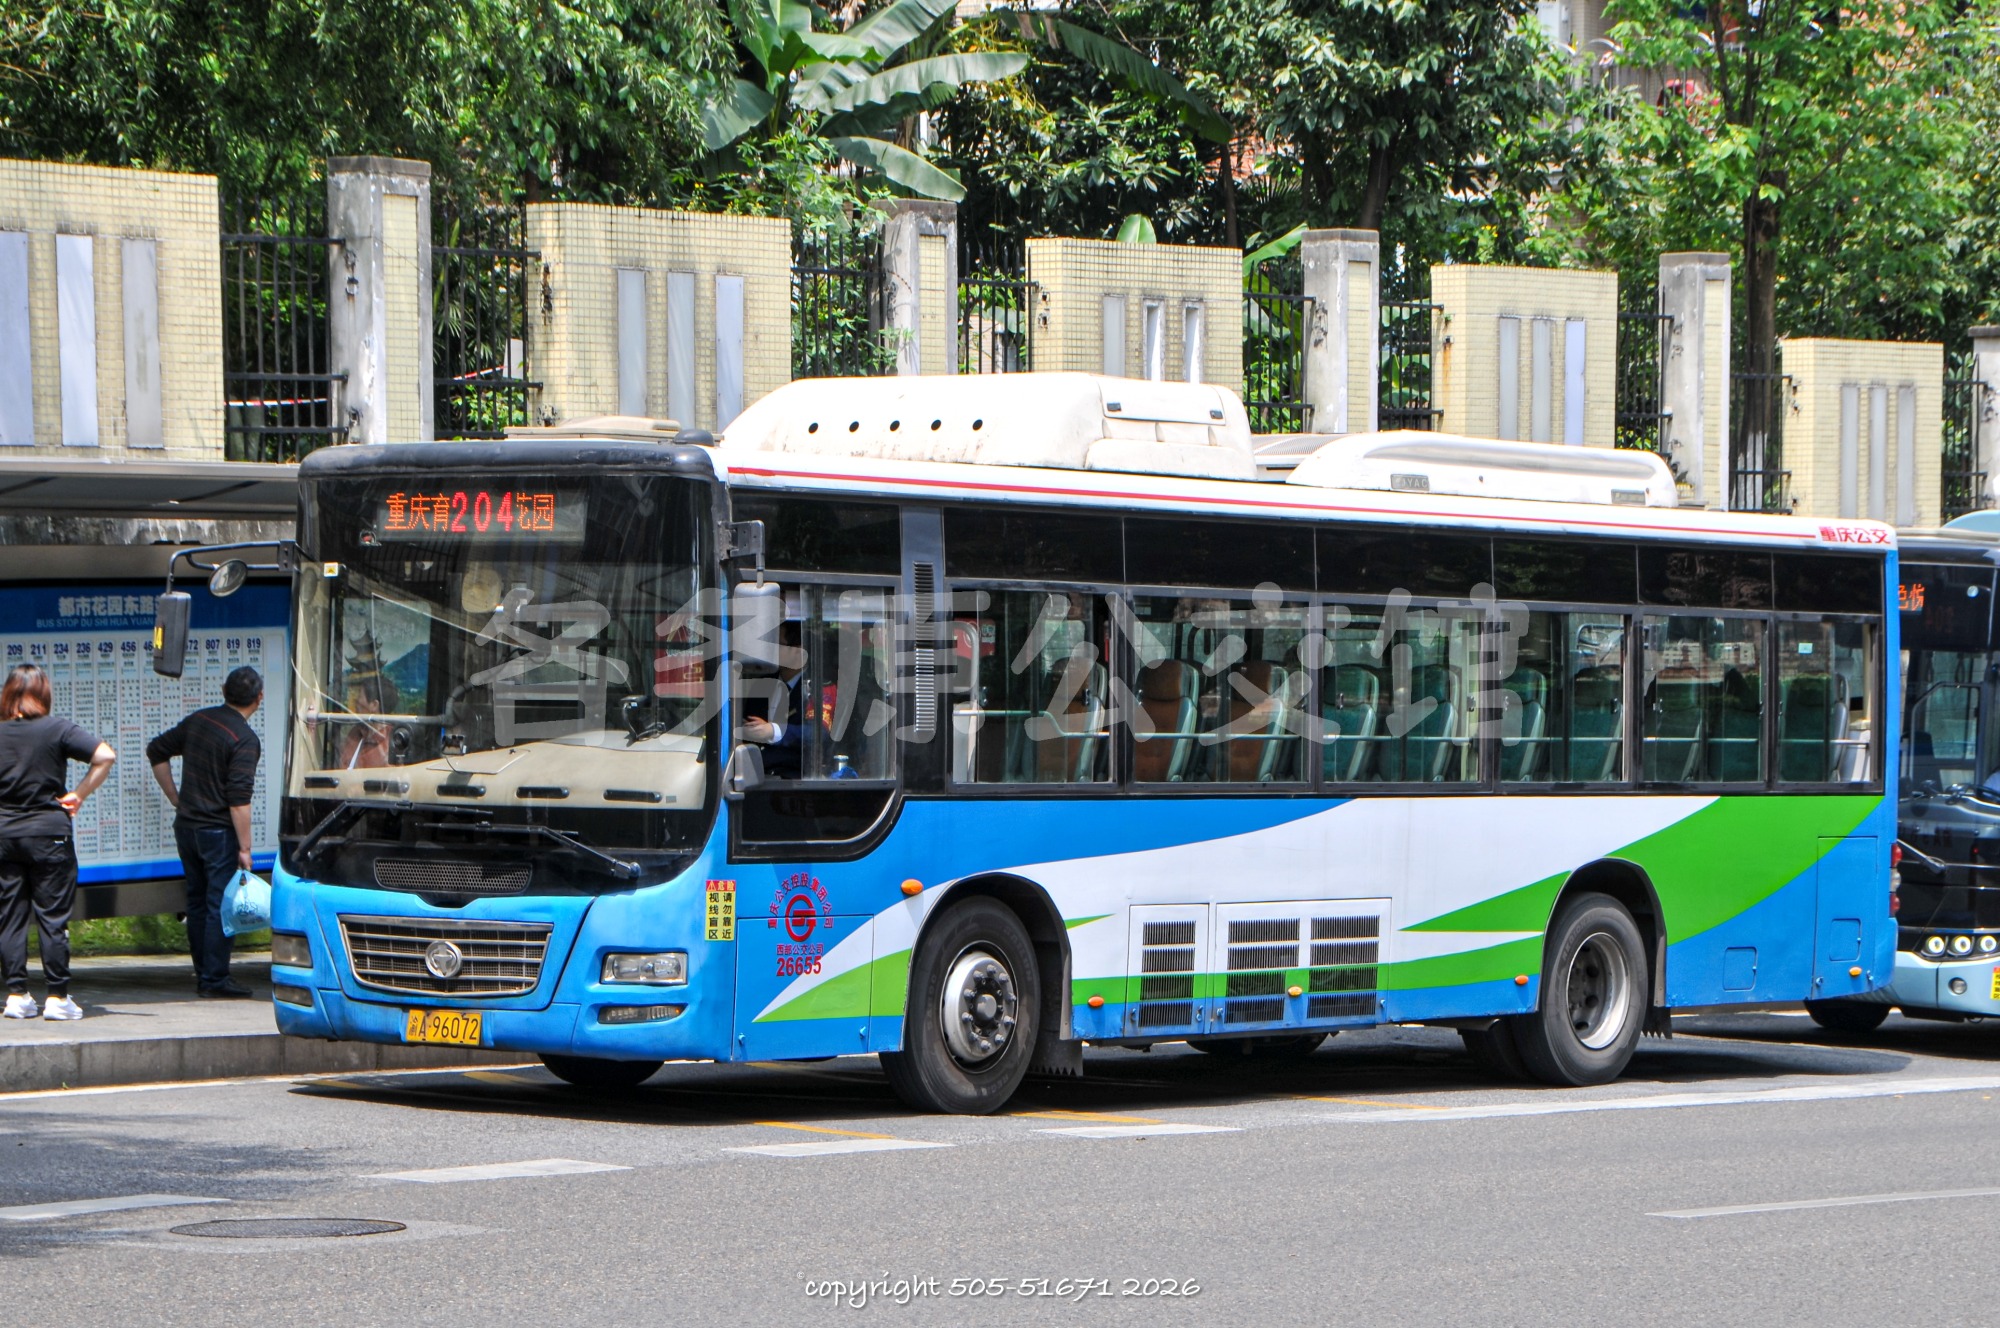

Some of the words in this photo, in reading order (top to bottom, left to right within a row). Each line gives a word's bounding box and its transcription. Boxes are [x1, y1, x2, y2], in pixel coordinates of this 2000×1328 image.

[1818, 526, 1891, 545] 重庆公交
[36, 618, 55, 628] BUS
[56, 618, 79, 628] STOP
[80, 618, 93, 627] DU
[94, 618, 108, 627] SHI
[109, 617, 129, 627] HUA
[131, 617, 154, 626] YUAN
[30, 643, 47, 655] 211
[53, 643, 69, 654] 234
[76, 642, 91, 654] 236
[98, 641, 113, 653] 429
[120, 641, 137, 652] 456
[205, 638, 220, 650] 807
[226, 638, 240, 649] 819
[247, 637, 261, 649] 819
[7, 644, 23, 655] 209
[708, 892, 720, 940] 视线盲区
[722, 892, 733, 940] 请勿靠近
[776, 943, 824, 956] 西部公交公司
[776, 955, 822, 977] 26655
